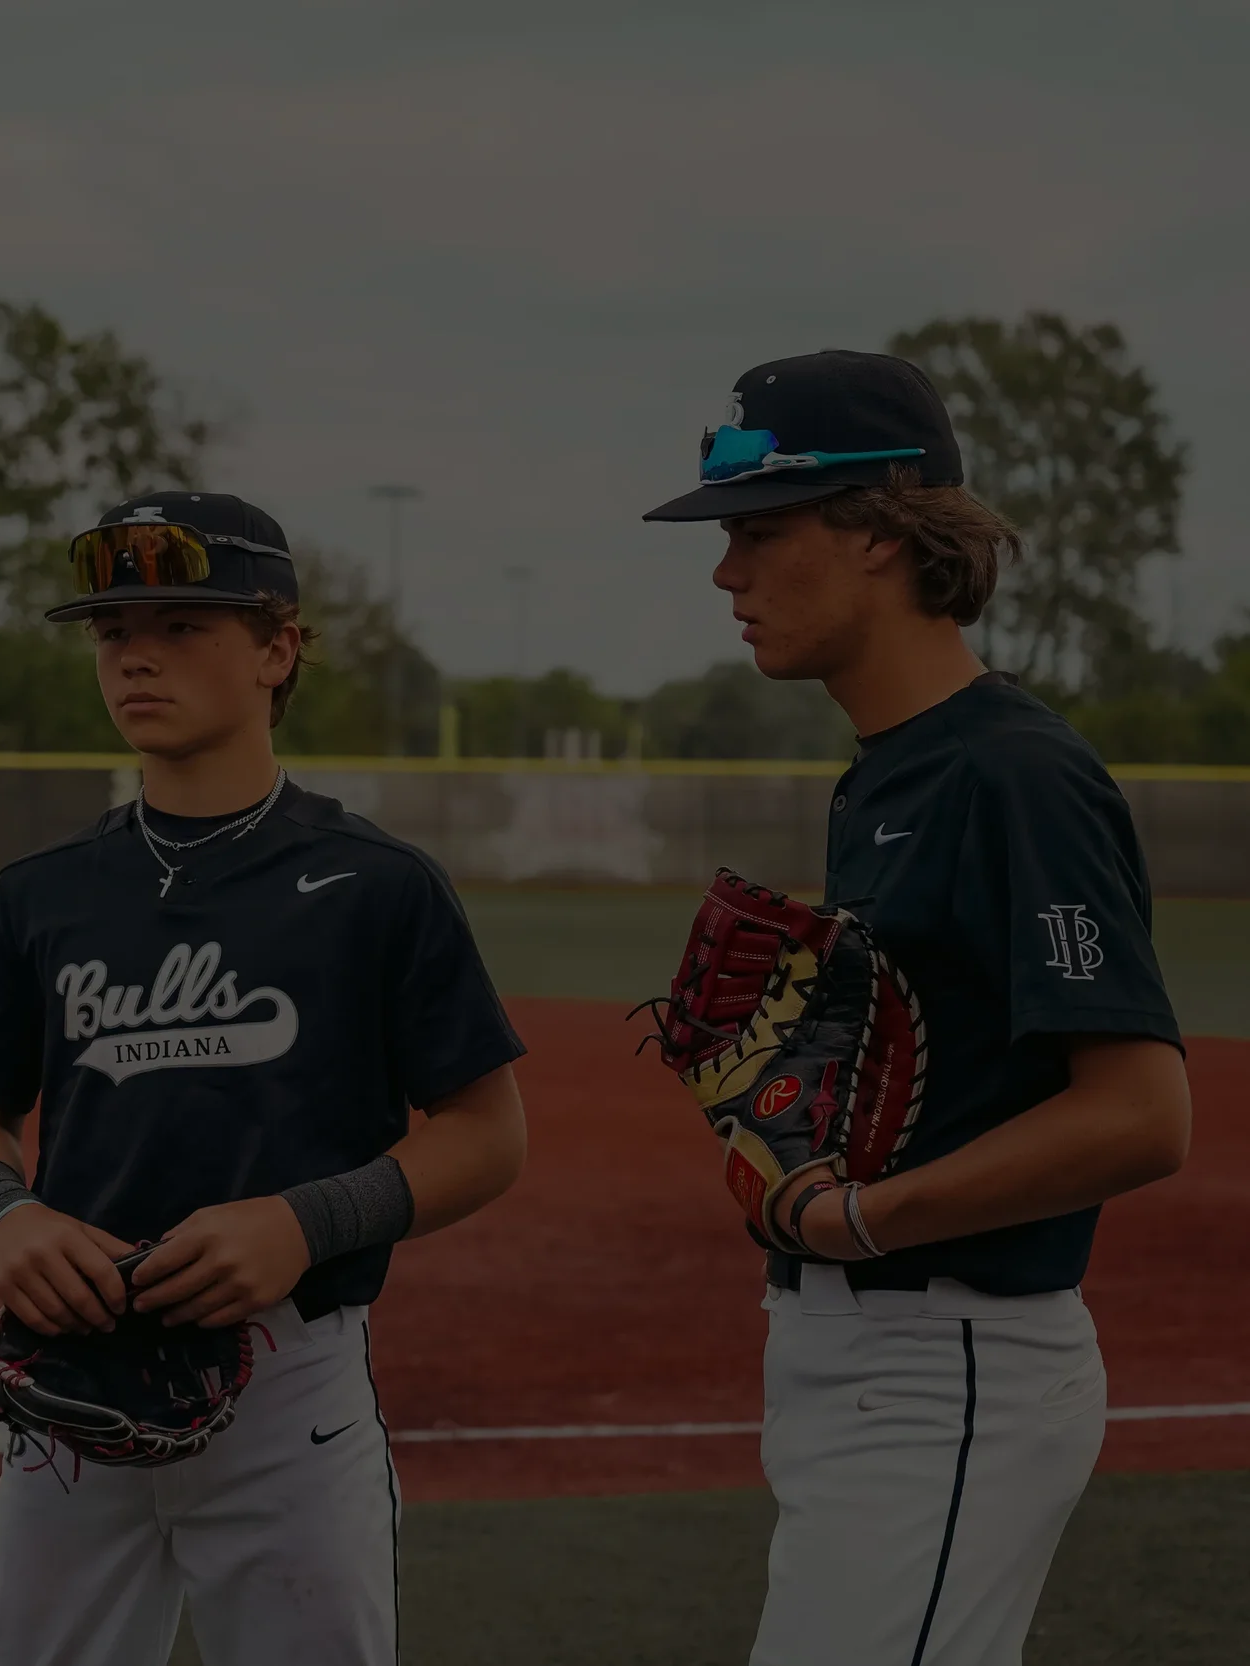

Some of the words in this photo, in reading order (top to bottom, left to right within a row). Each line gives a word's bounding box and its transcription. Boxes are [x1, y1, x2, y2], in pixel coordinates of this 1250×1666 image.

[55, 941, 239, 1041] Bulls
[113, 1036, 232, 1063] INDIANA
[871, 1063, 893, 1127] PROFESSIONAL
[864, 1140, 873, 1153] For
[869, 1128, 877, 1141] the
